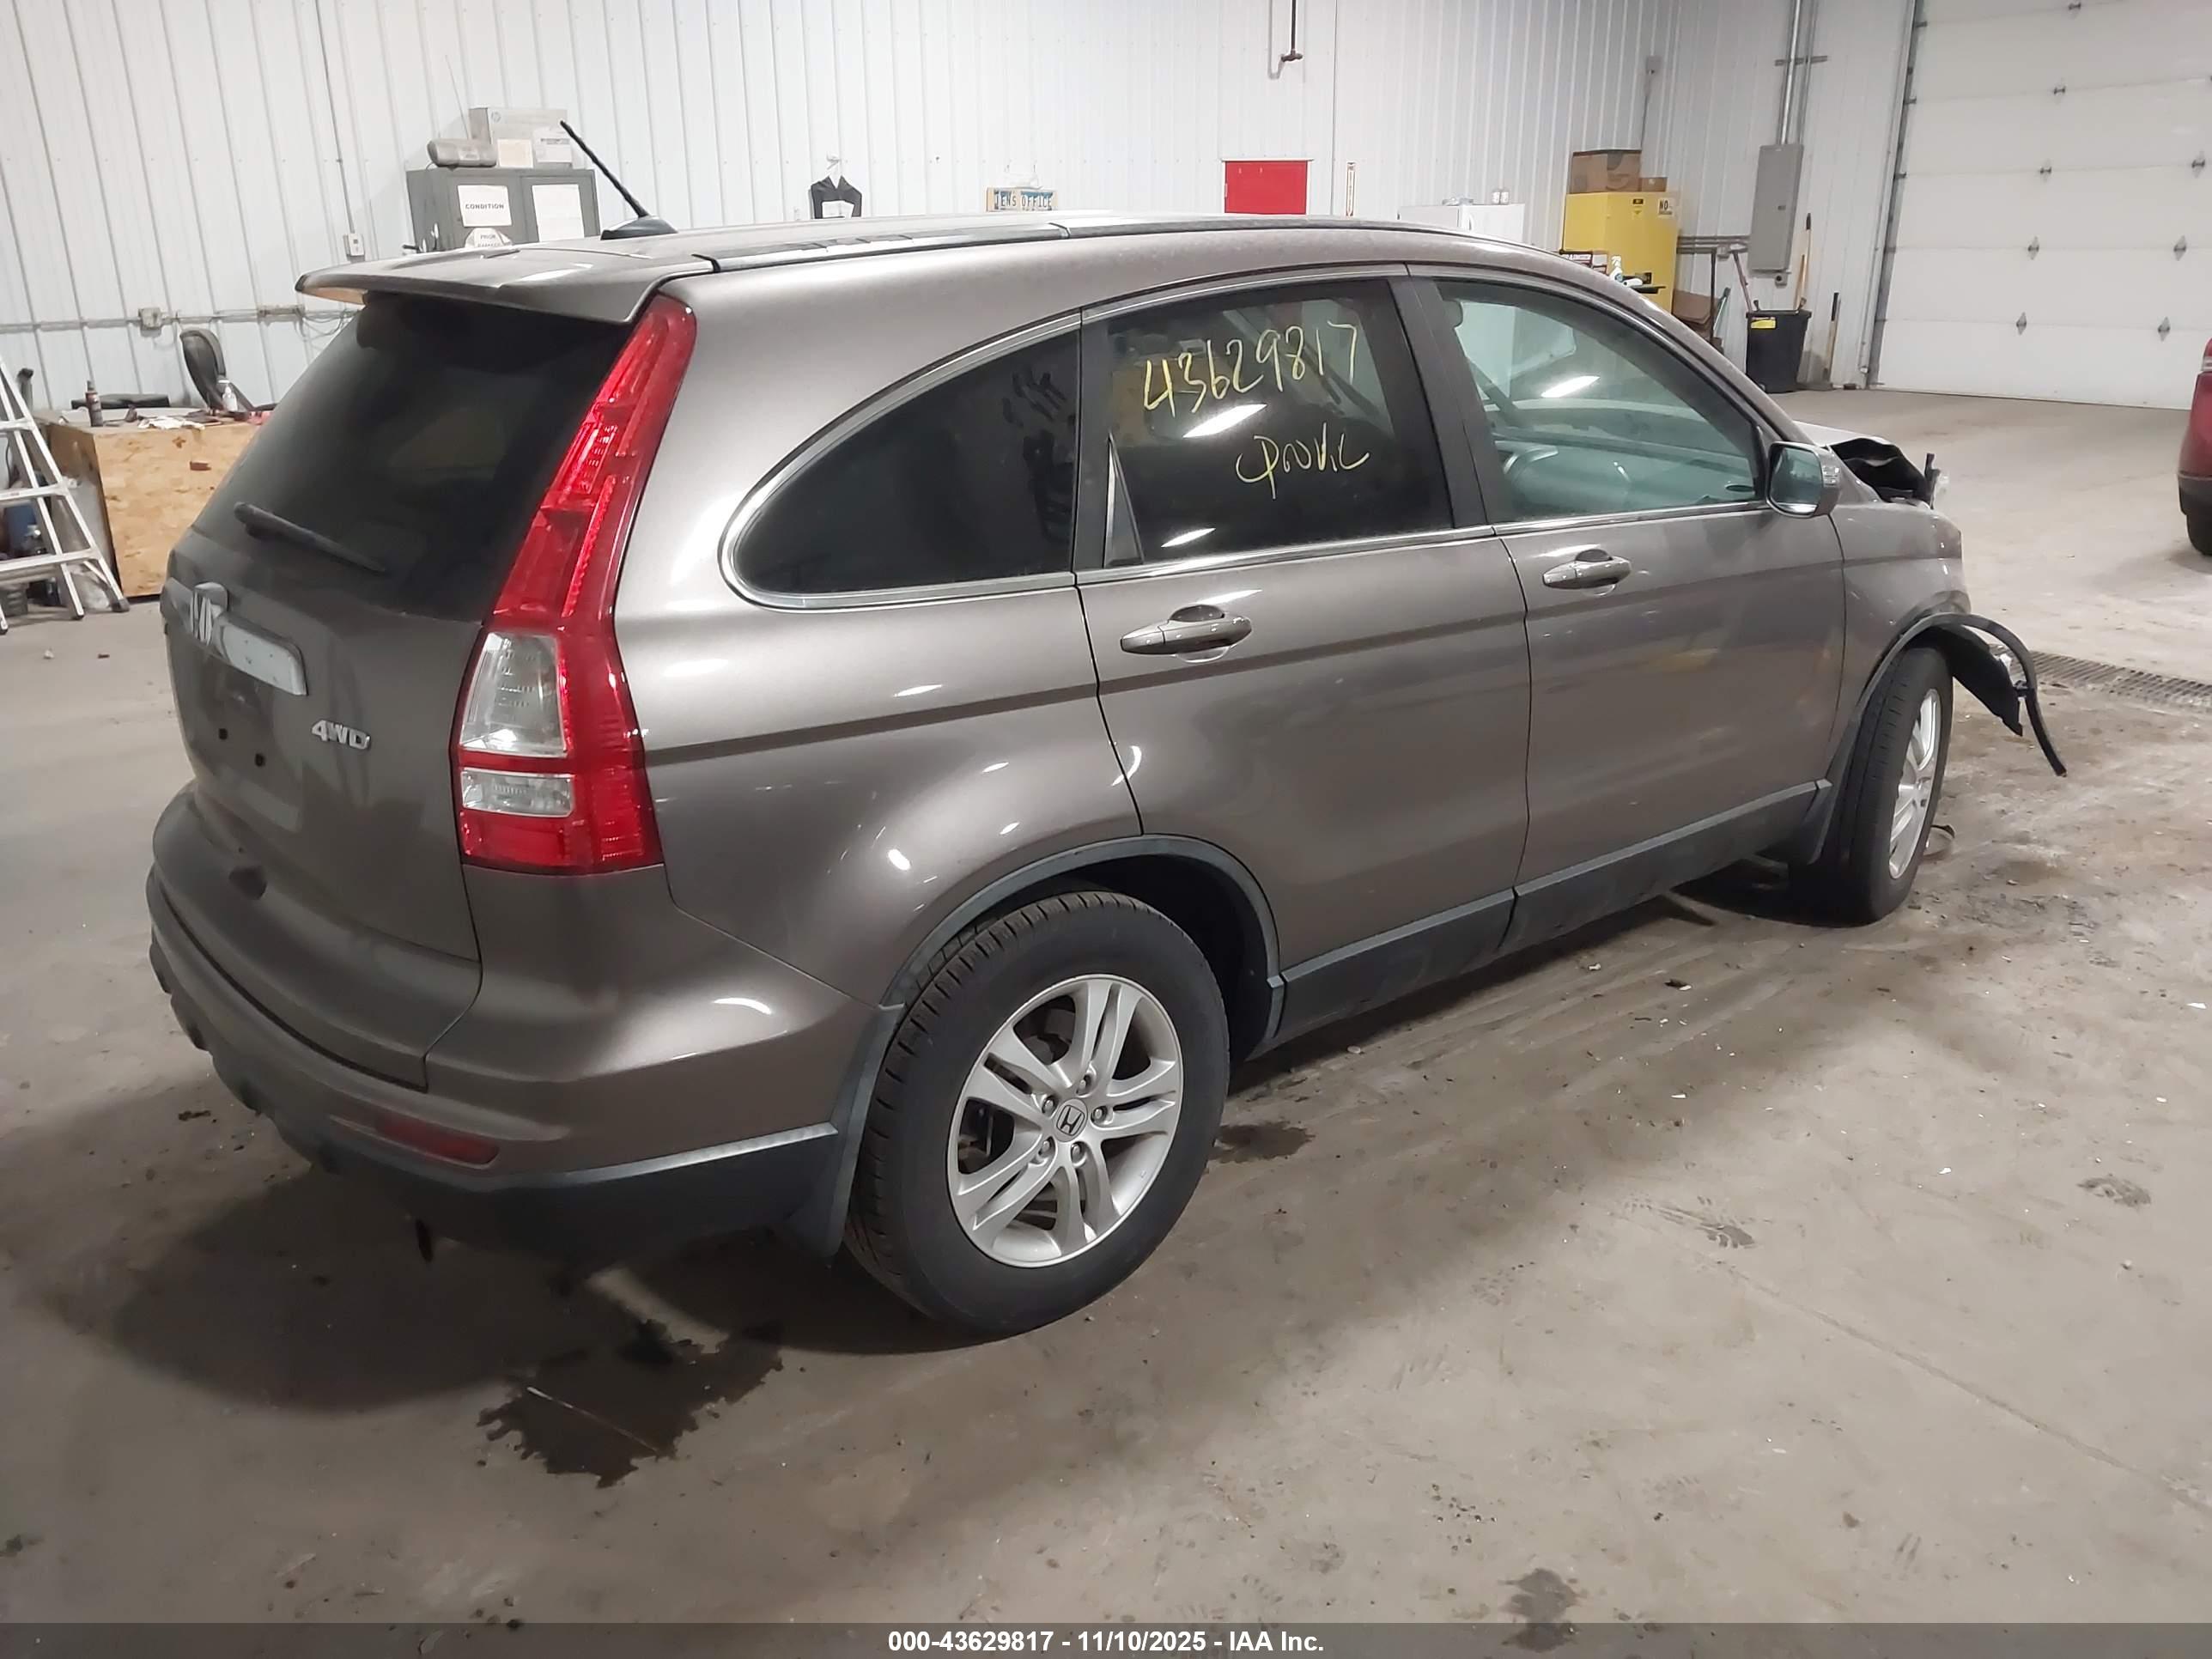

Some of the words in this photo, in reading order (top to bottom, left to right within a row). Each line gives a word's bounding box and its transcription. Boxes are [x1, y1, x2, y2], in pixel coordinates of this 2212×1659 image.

[1020, 192, 1053, 208] OFFICE
[1143, 319, 1358, 418] 43629817
[312, 720, 370, 749] 4WD
